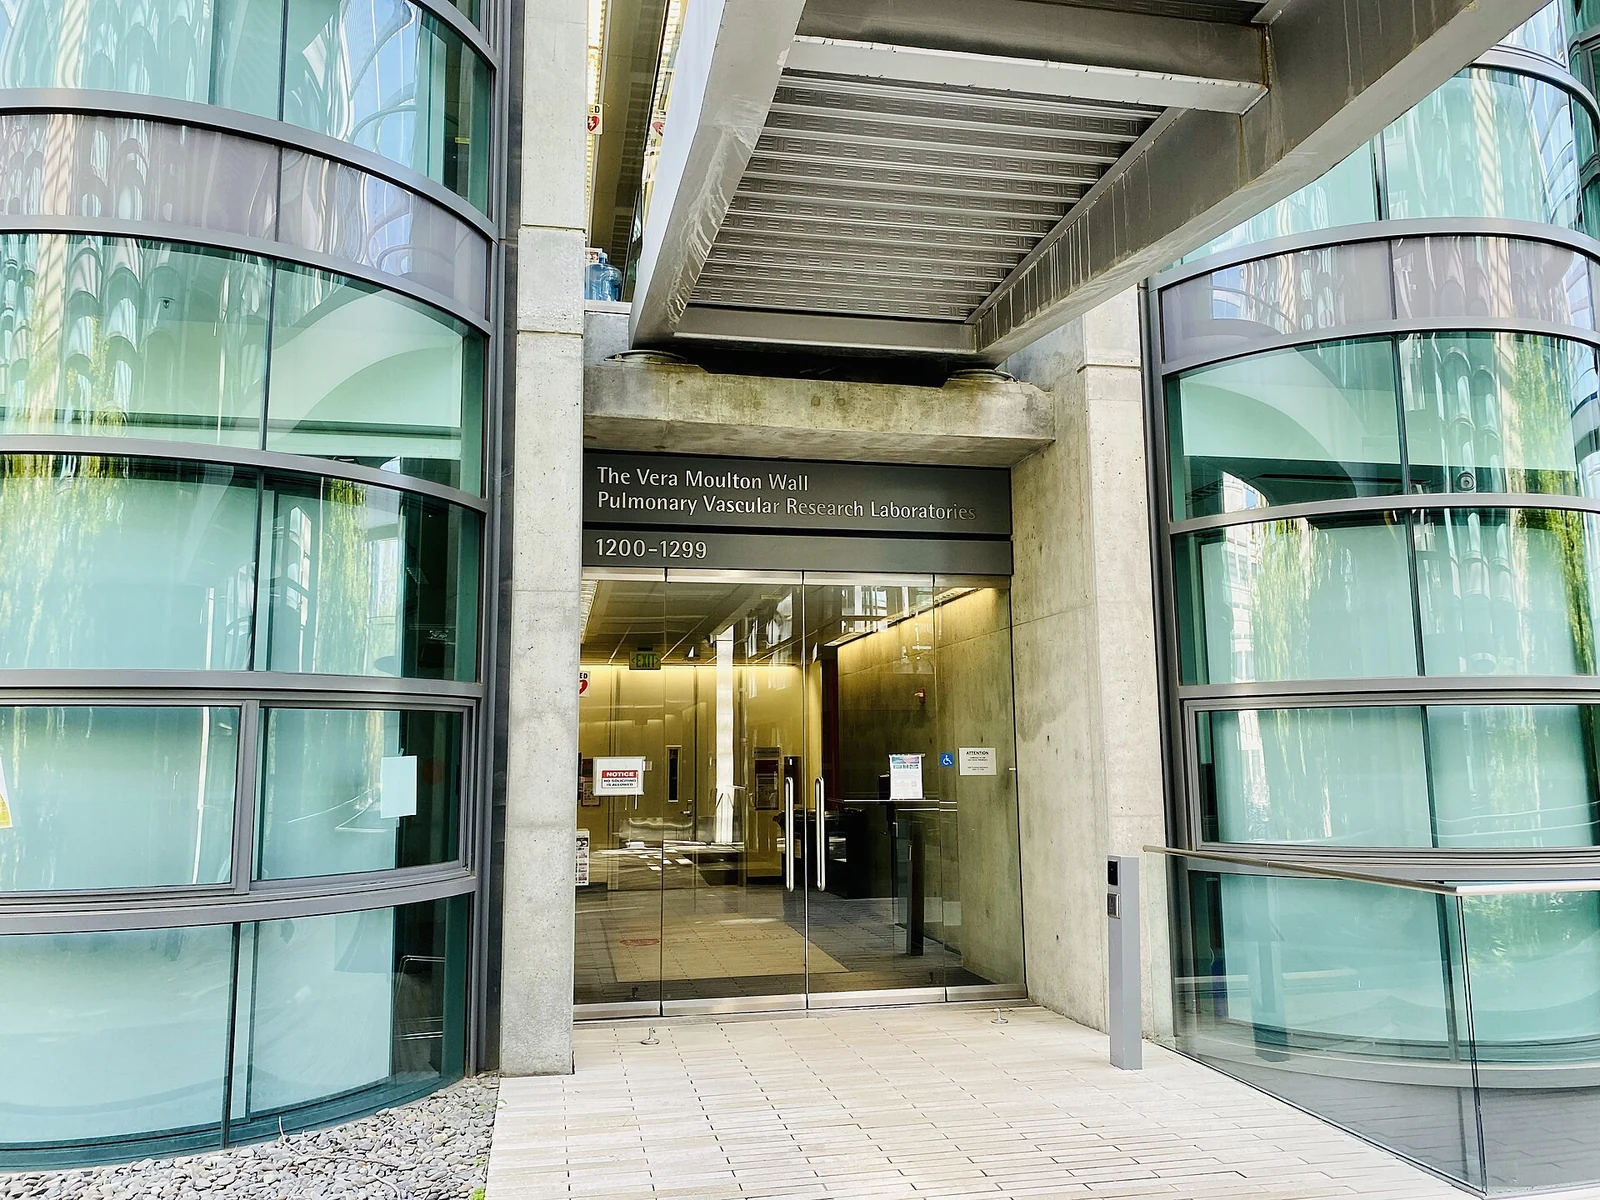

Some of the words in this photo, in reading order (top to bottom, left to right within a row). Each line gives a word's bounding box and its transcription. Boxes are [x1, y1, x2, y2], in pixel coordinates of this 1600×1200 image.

[597, 466, 631, 485] The
[637, 468, 678, 487] Vera
[685, 470, 762, 490] Moulton
[768, 473, 809, 492] Wall
[598, 491, 698, 516] Pulmonary
[702, 495, 780, 514] Vascular
[786, 497, 864, 517] Research
[870, 500, 976, 520] Laboratories
[595, 538, 708, 559] 1200-1299
[635, 653, 657, 668] EXIT
